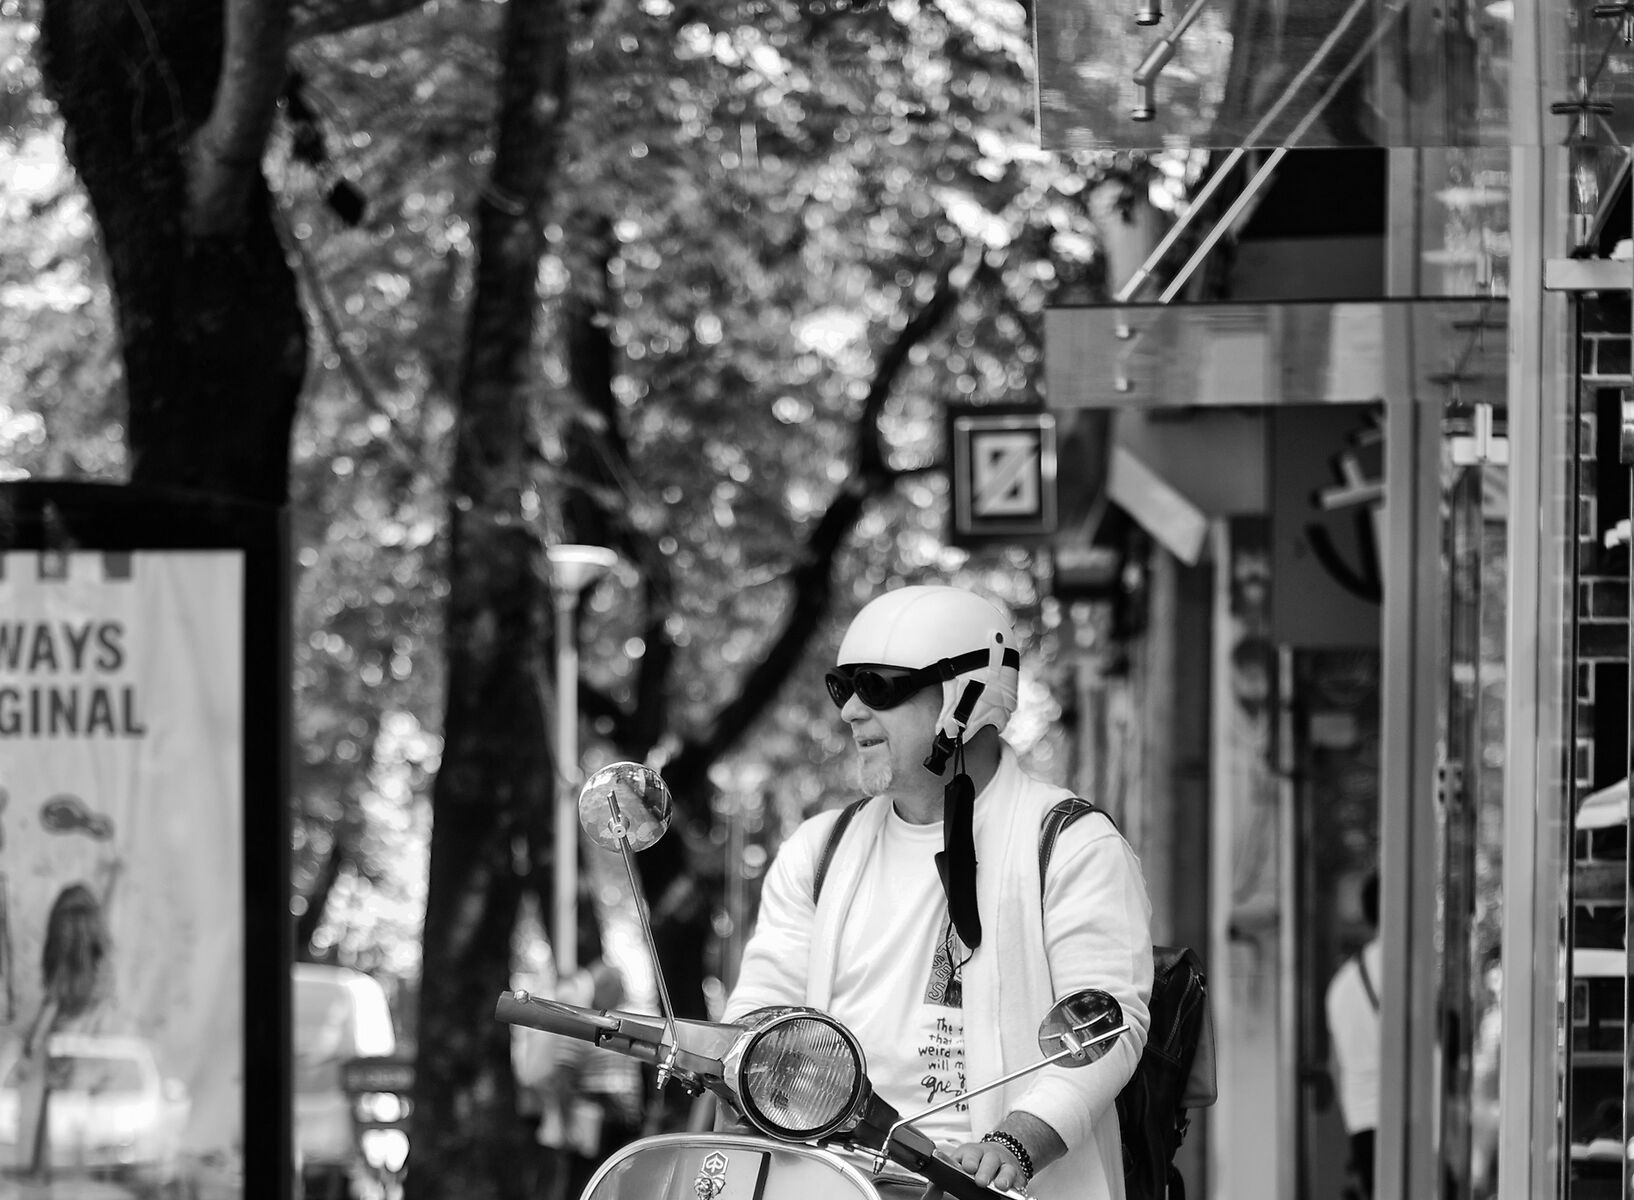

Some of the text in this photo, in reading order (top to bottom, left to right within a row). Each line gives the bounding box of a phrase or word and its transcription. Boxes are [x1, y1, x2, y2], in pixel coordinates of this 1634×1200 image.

[936, 1017, 953, 1035] The
[918, 1045, 951, 1058] weird
[927, 1059, 949, 1072] will
